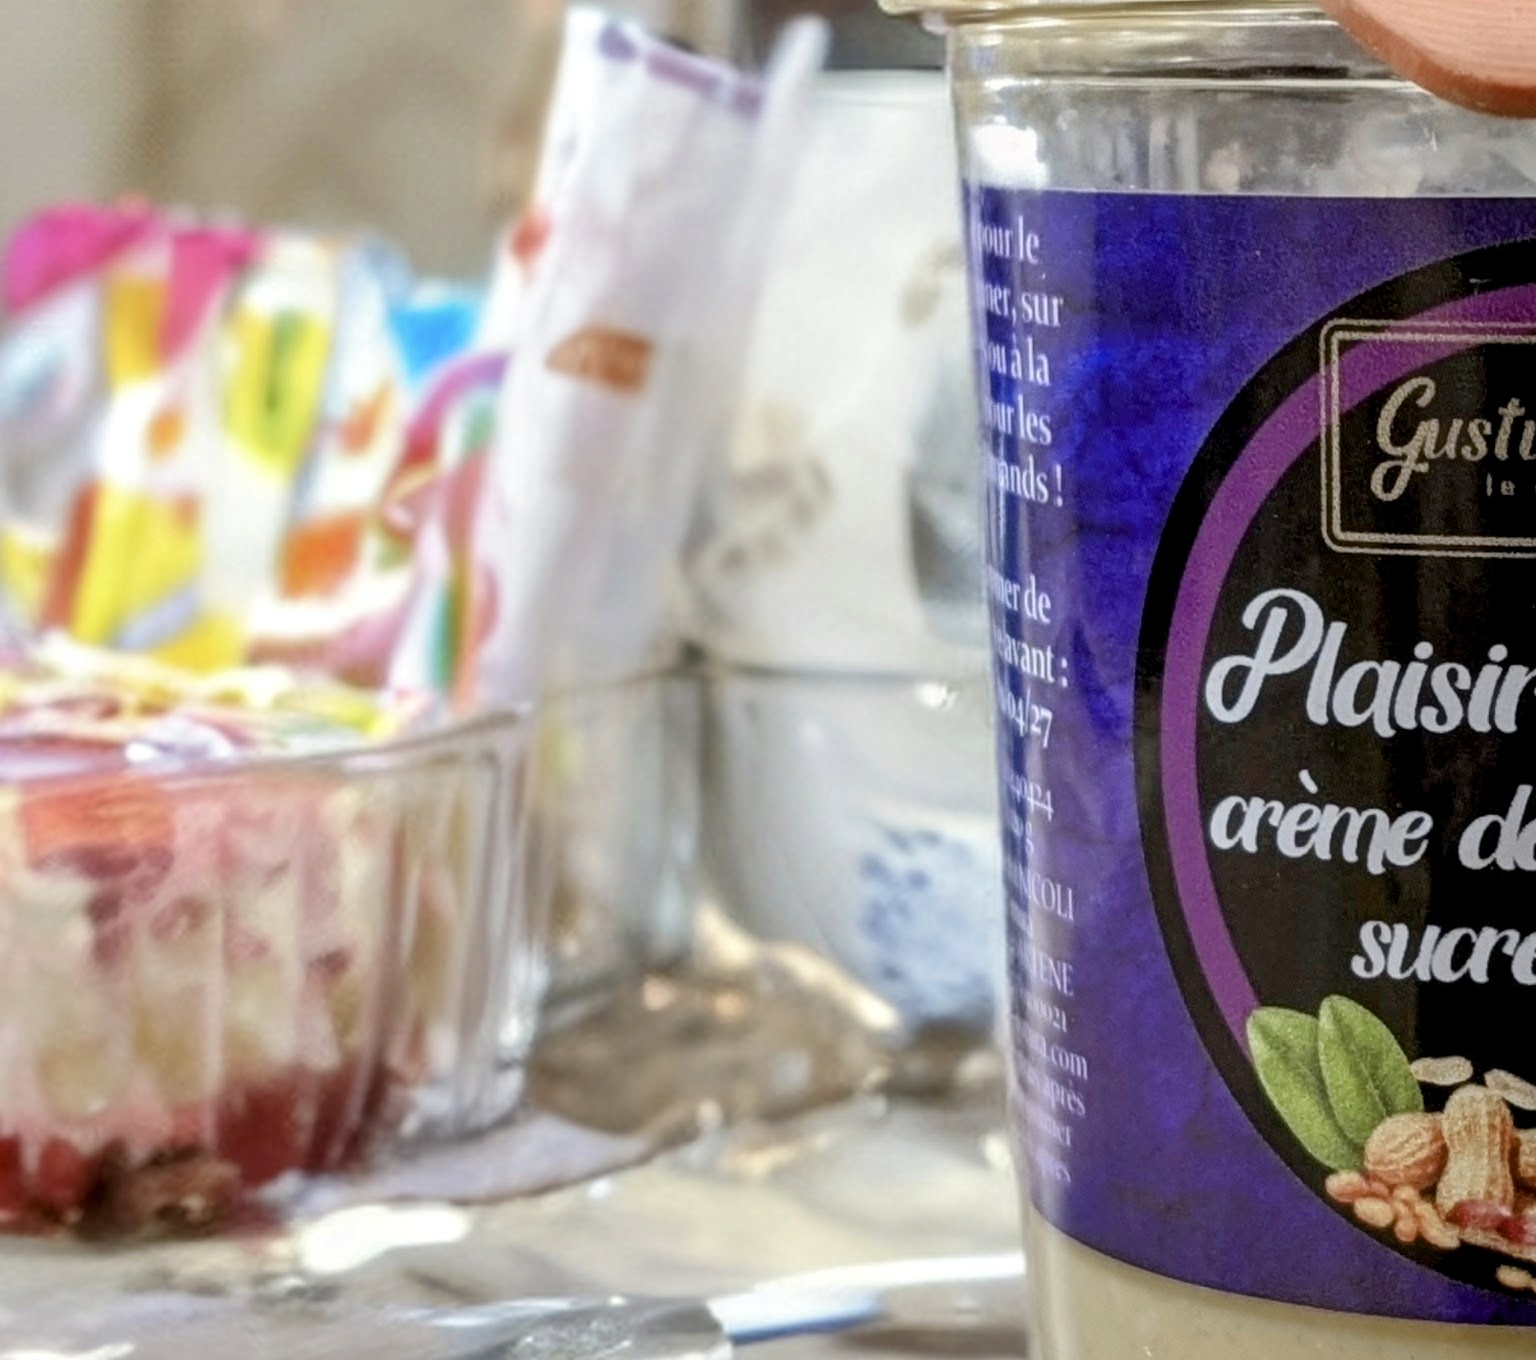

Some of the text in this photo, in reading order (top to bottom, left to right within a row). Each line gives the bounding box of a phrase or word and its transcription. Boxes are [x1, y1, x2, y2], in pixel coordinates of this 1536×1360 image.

[1017, 215, 1040, 265] le
[1020, 291, 1065, 327] sur
[1026, 334, 1051, 387] la
[1017, 393, 1053, 446] les
[1486, 472, 1515, 496] le
[1023, 573, 1051, 624] de
[1210, 769, 1433, 875] crème
